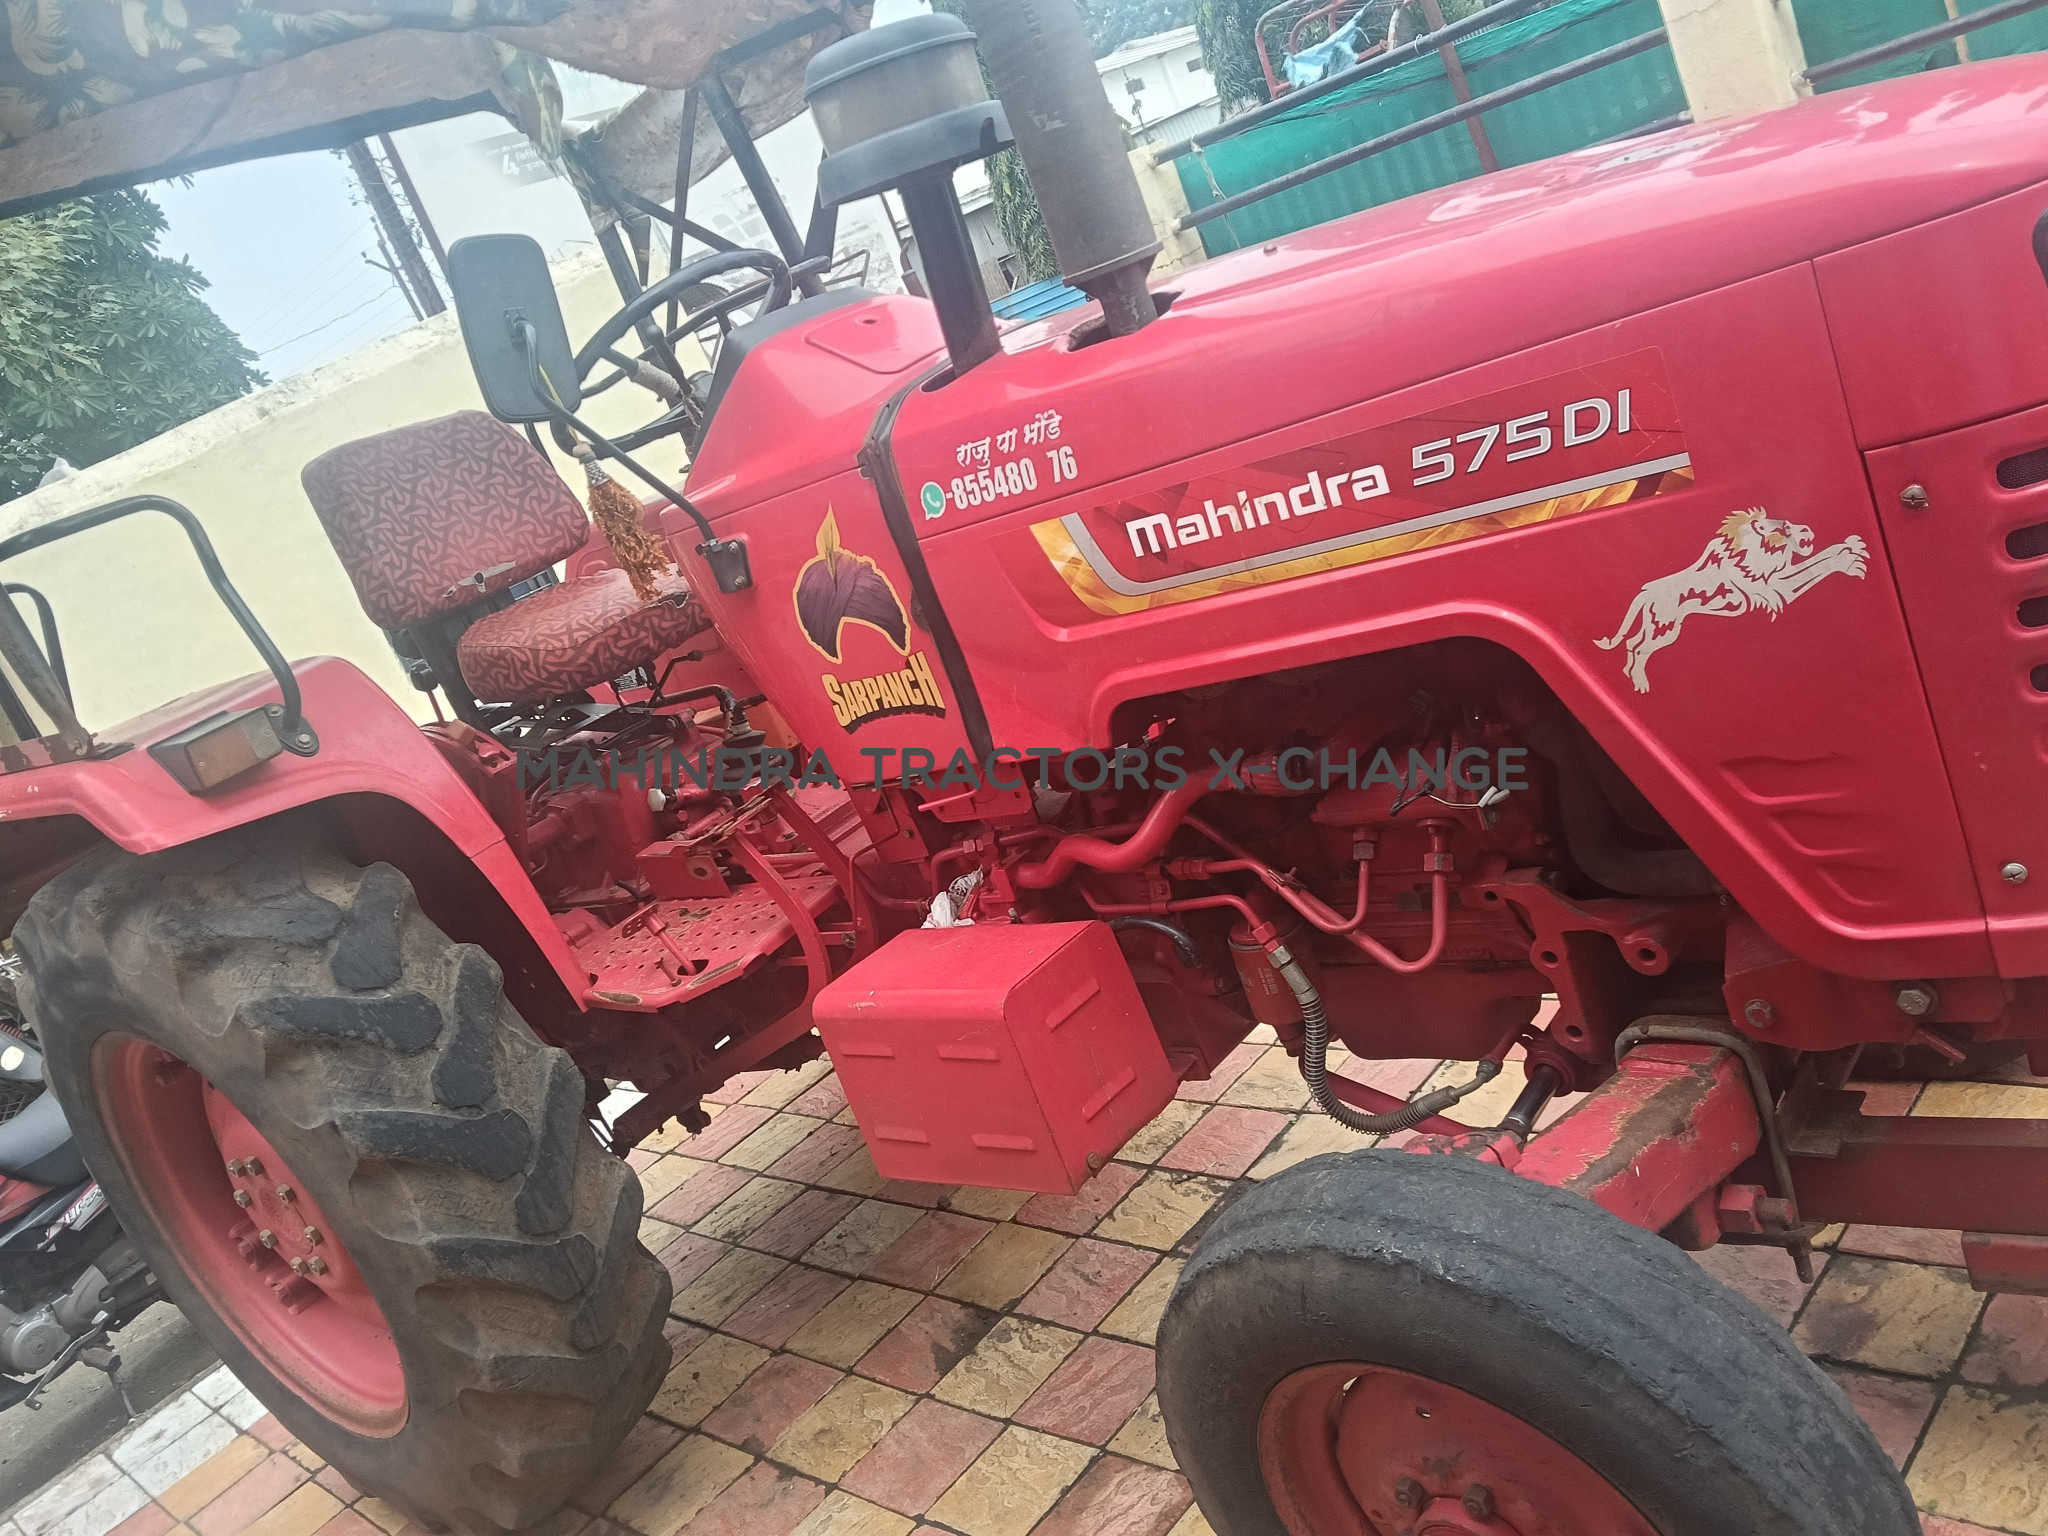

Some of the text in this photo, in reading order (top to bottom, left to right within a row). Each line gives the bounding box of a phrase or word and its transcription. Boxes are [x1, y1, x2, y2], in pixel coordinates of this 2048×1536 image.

[502, 153, 520, 176] 4
[1411, 410, 1552, 487] 575
[1563, 388, 1631, 448] DI
[1046, 445, 1079, 484] 76
